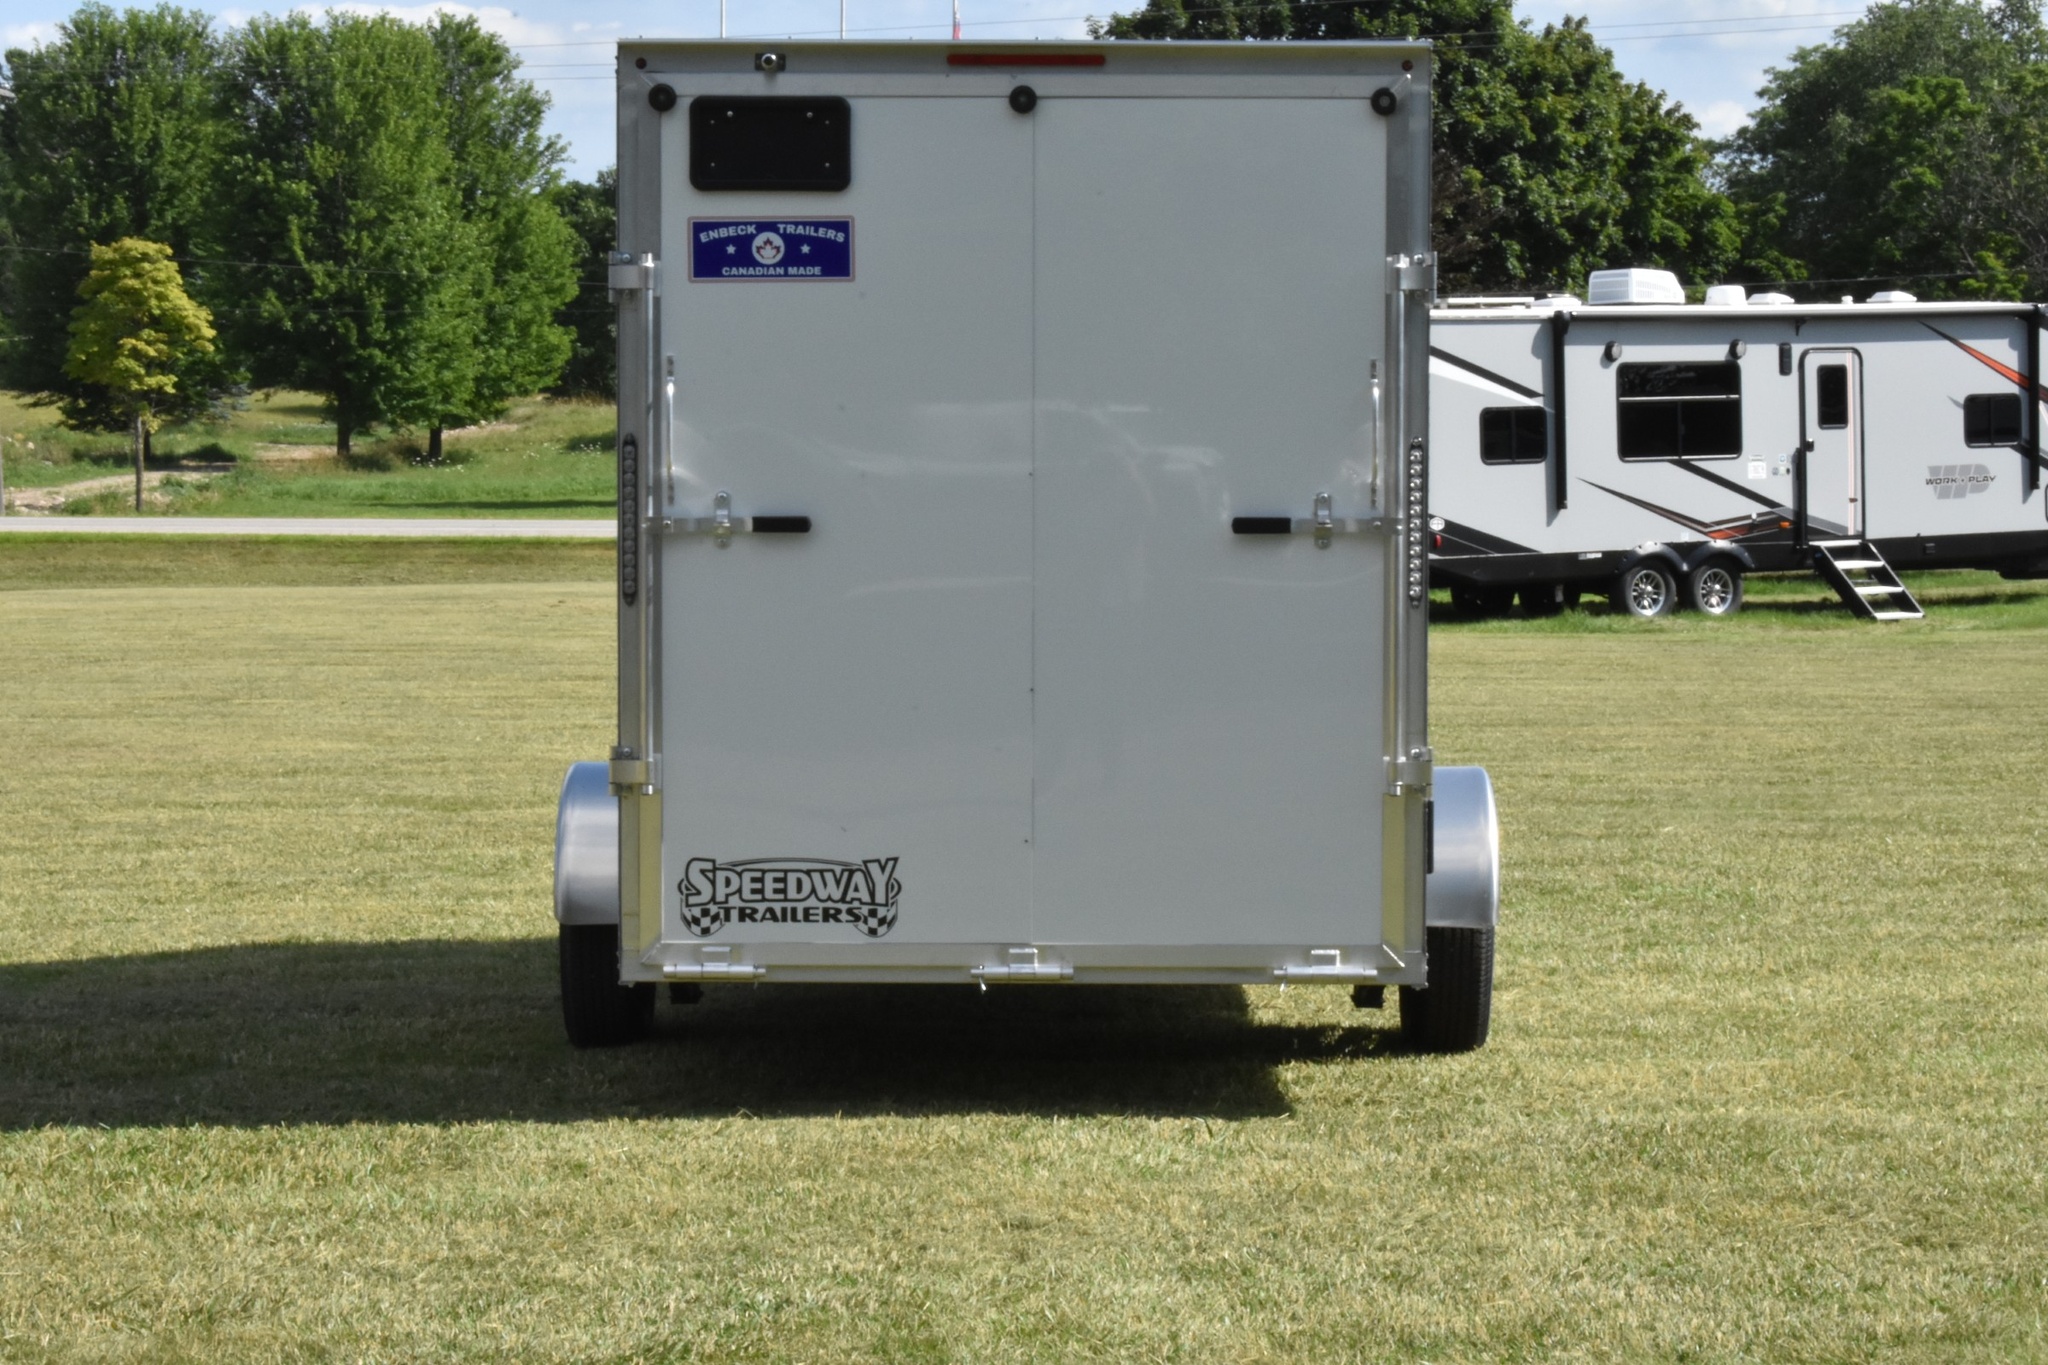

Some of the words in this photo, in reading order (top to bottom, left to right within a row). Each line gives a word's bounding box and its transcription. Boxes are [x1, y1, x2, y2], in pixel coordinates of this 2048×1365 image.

[700, 224, 757, 243] ENBECK
[776, 223, 846, 243] TRAILERS
[721, 266, 784, 276] CANADIAN
[787, 266, 822, 275] MADE
[1925, 477, 1958, 486] WORK
[1968, 475, 1997, 483] PLAY
[685, 857, 899, 908] SPEEDWAY
[717, 906, 865, 923] TRAILERS
